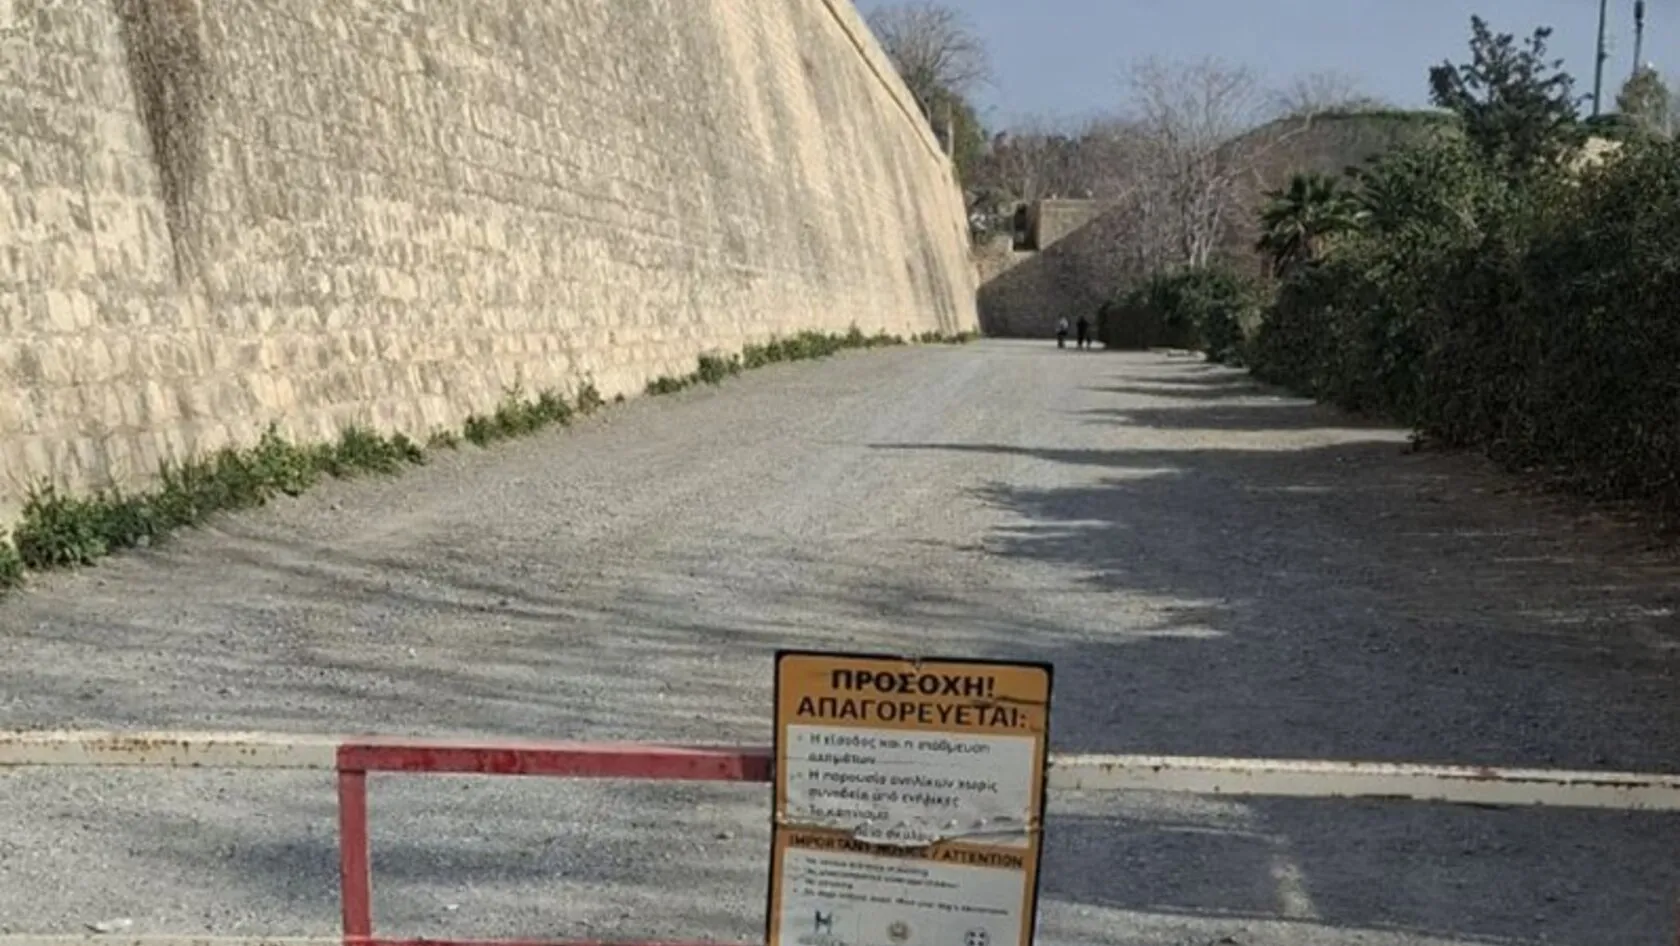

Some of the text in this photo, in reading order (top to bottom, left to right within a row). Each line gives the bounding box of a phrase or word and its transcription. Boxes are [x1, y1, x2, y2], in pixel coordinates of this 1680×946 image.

[831, 669, 995, 698] ΠΡΟΣΟΧΗ!
[796, 696, 1029, 728] ΑΠΑΓΟΡΕΥΕΤΑΙ:
[943, 848, 1024, 870] ATTENTION
